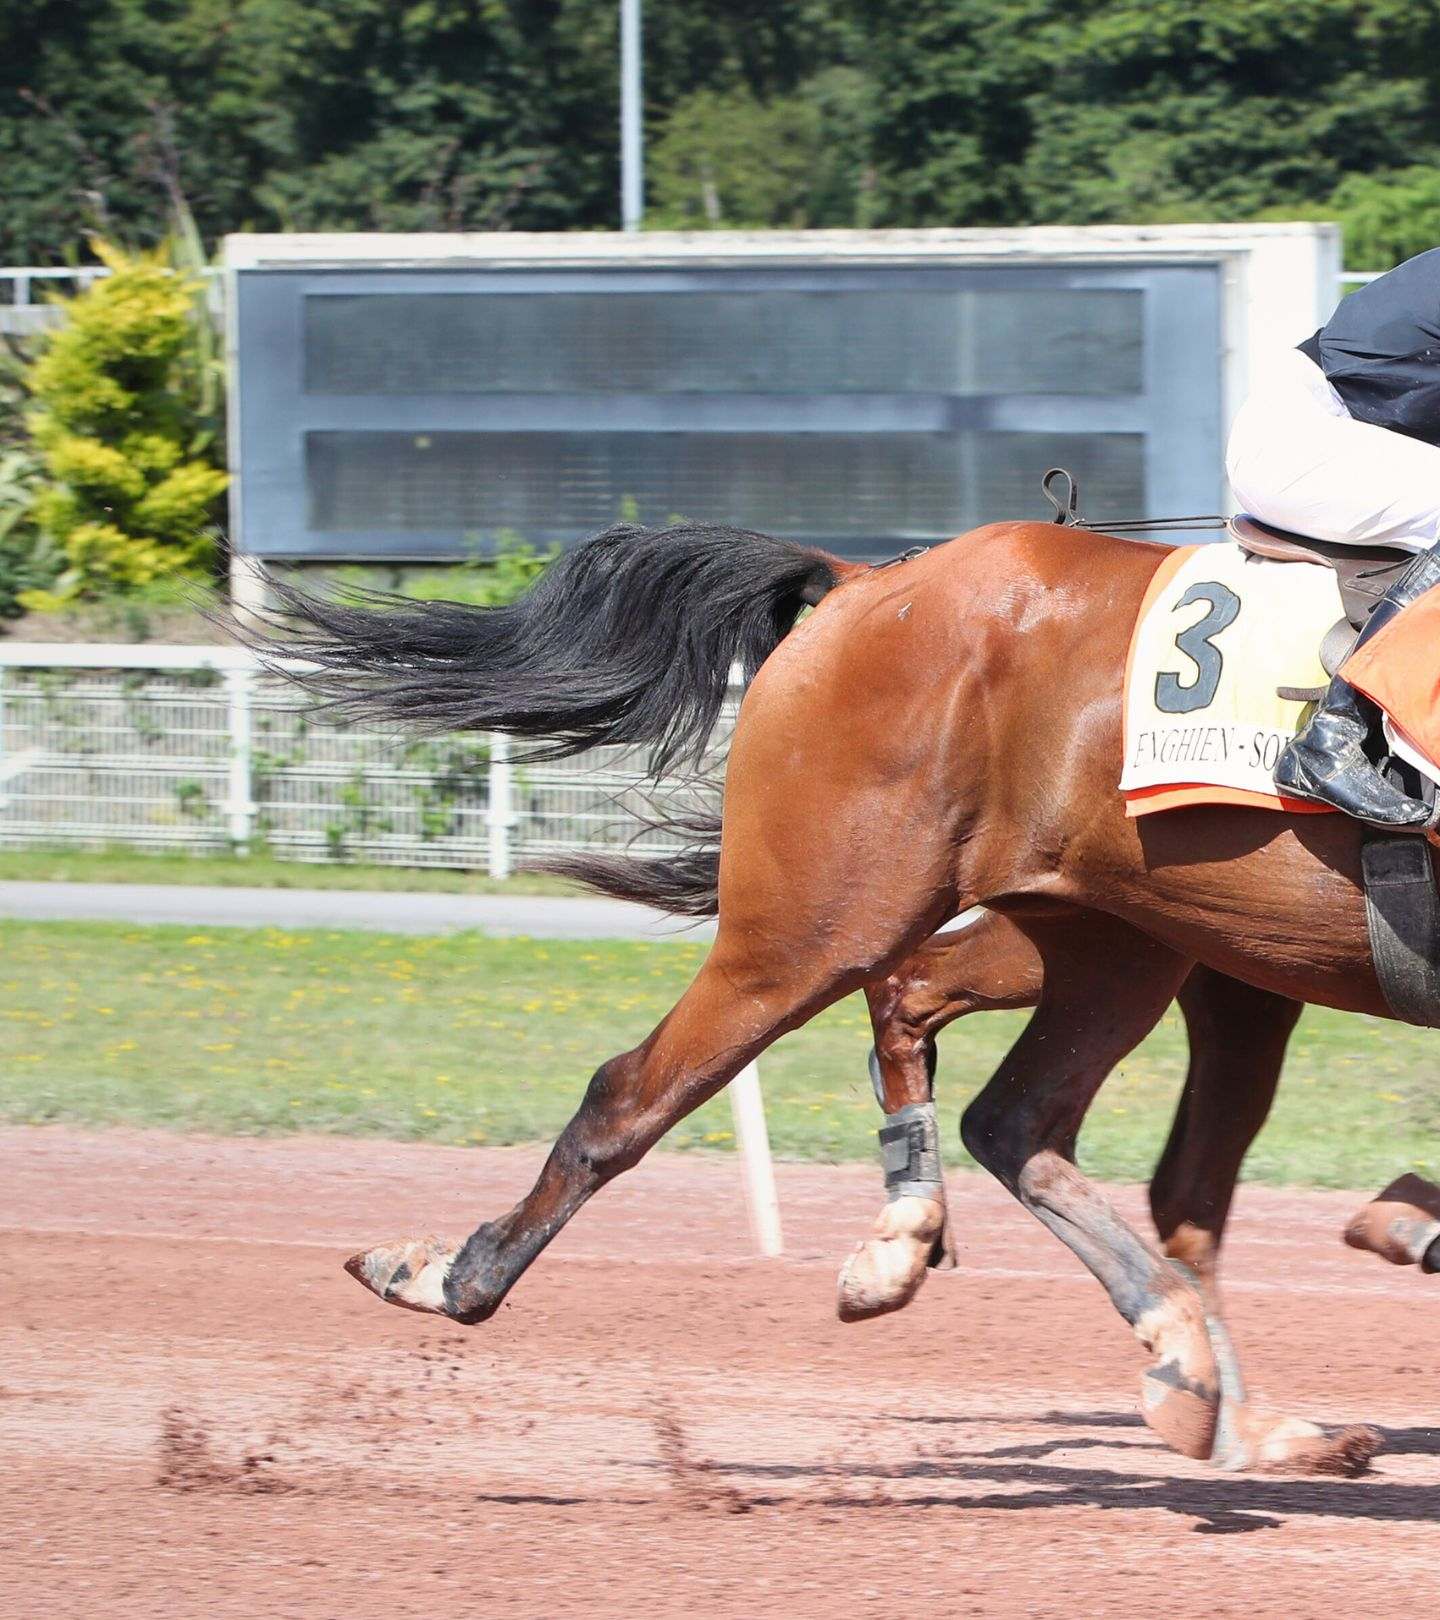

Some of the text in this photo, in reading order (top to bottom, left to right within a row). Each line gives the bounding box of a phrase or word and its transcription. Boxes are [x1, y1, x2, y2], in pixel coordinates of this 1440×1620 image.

[1154, 581, 1241, 714] 3
[1133, 727, 1235, 768] ENGHIEN
[1248, 731, 1291, 772] SO
